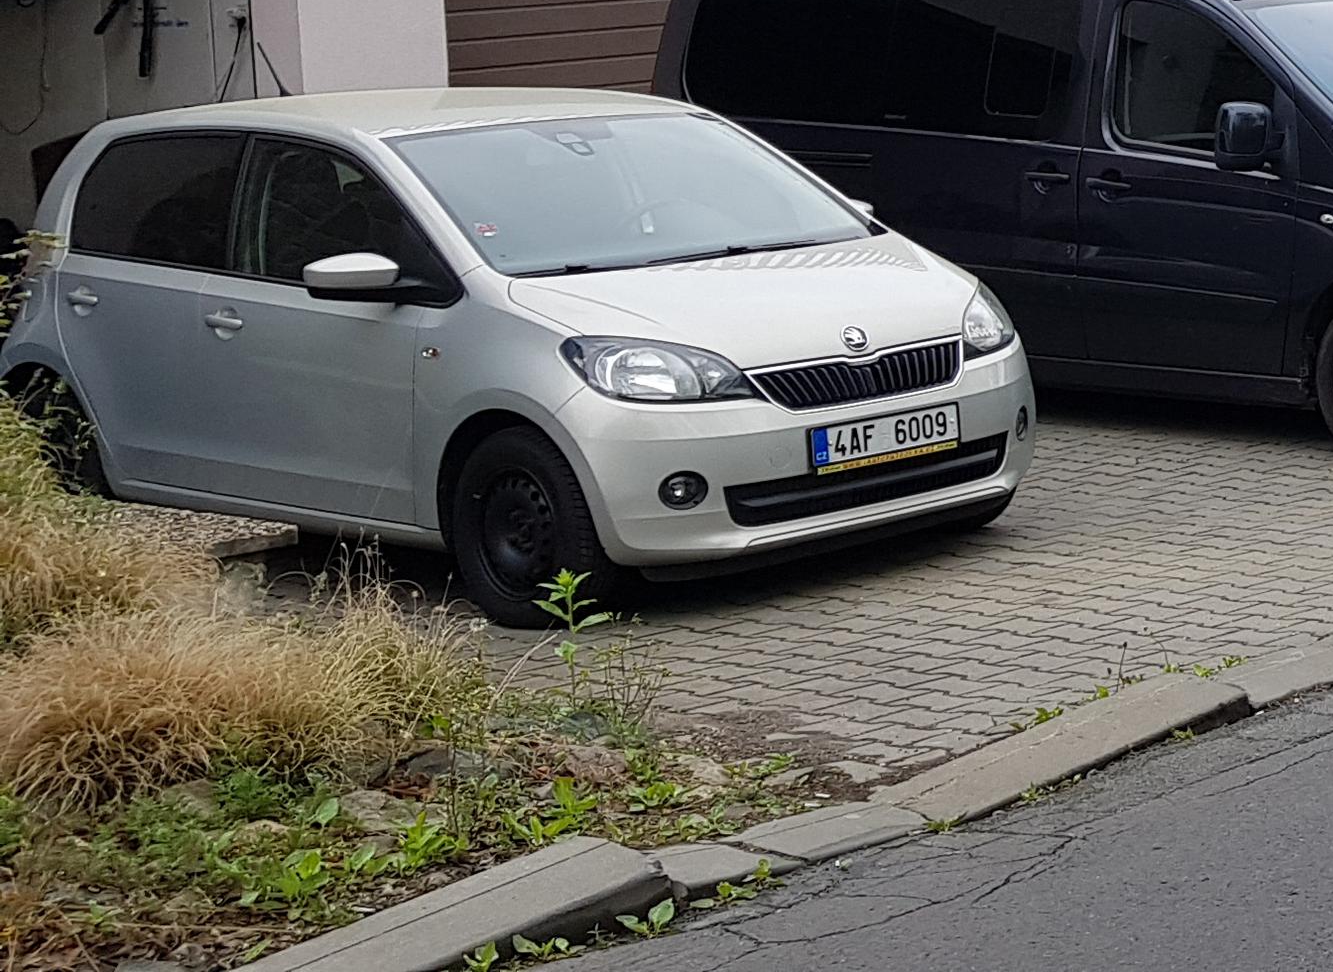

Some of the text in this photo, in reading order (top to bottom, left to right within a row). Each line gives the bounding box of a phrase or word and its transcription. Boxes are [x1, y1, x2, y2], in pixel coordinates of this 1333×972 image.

[834, 424, 875, 457] 4AF
[894, 411, 948, 445] 6009
[815, 451, 829, 462] CZ
